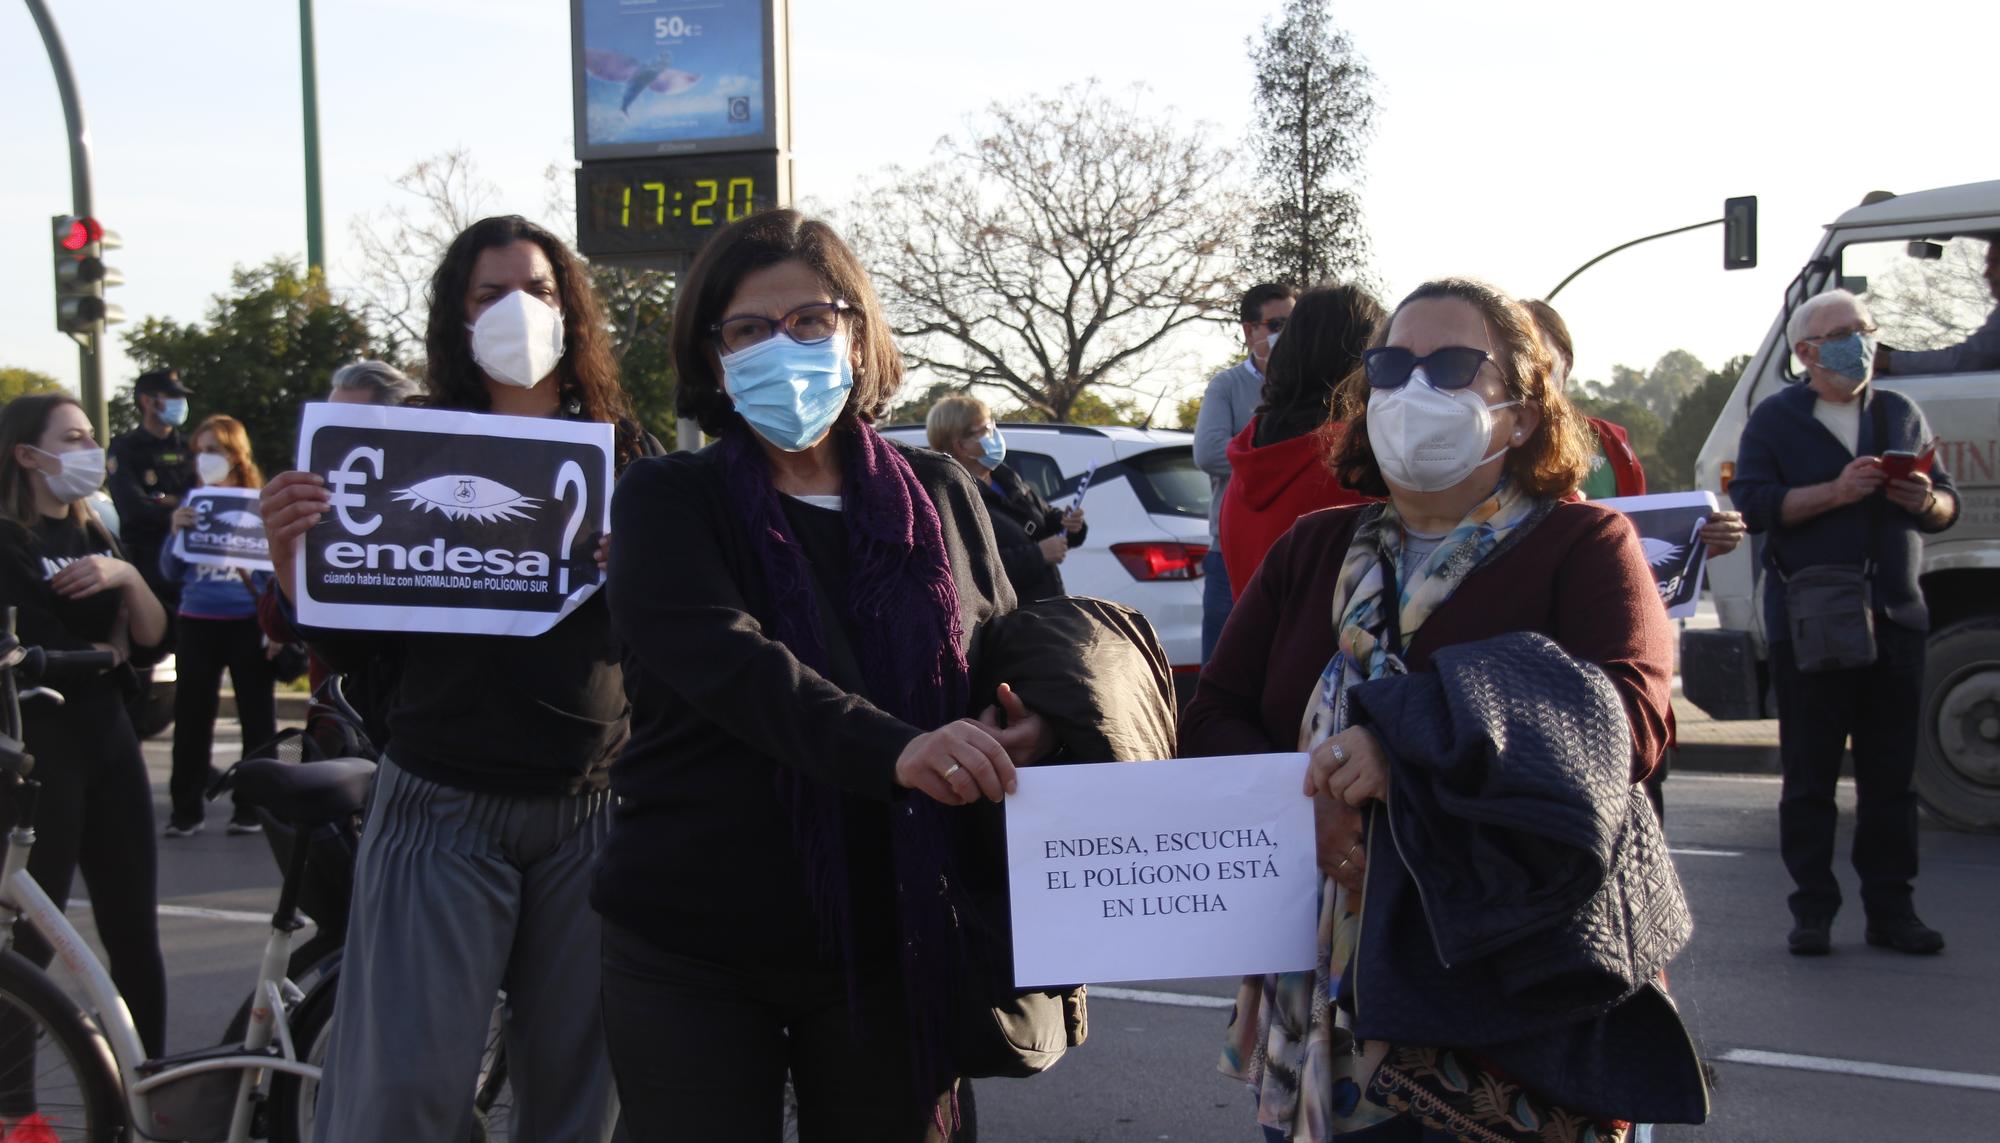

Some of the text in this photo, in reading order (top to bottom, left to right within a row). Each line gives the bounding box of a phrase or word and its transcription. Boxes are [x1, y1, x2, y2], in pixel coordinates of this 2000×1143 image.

[622, 178, 752, 227] 17:20
[189, 532, 269, 550] endesa
[324, 537, 550, 577] endesa
[357, 572, 381, 585] habrá
[383, 573, 396, 586] luz
[397, 576, 413, 586] con
[414, 574, 471, 589] NORMALIDAD
[472, 578, 483, 589] en
[484, 576, 528, 592] POLÍGONO
[529, 580, 549, 593] SUR
[1044, 828, 1278, 859] ENDESA, ESCUCHA,
[1047, 854, 1280, 890] EL POLÍGONO ESTÁ
[1102, 894, 1227, 918] EN LUCHA
